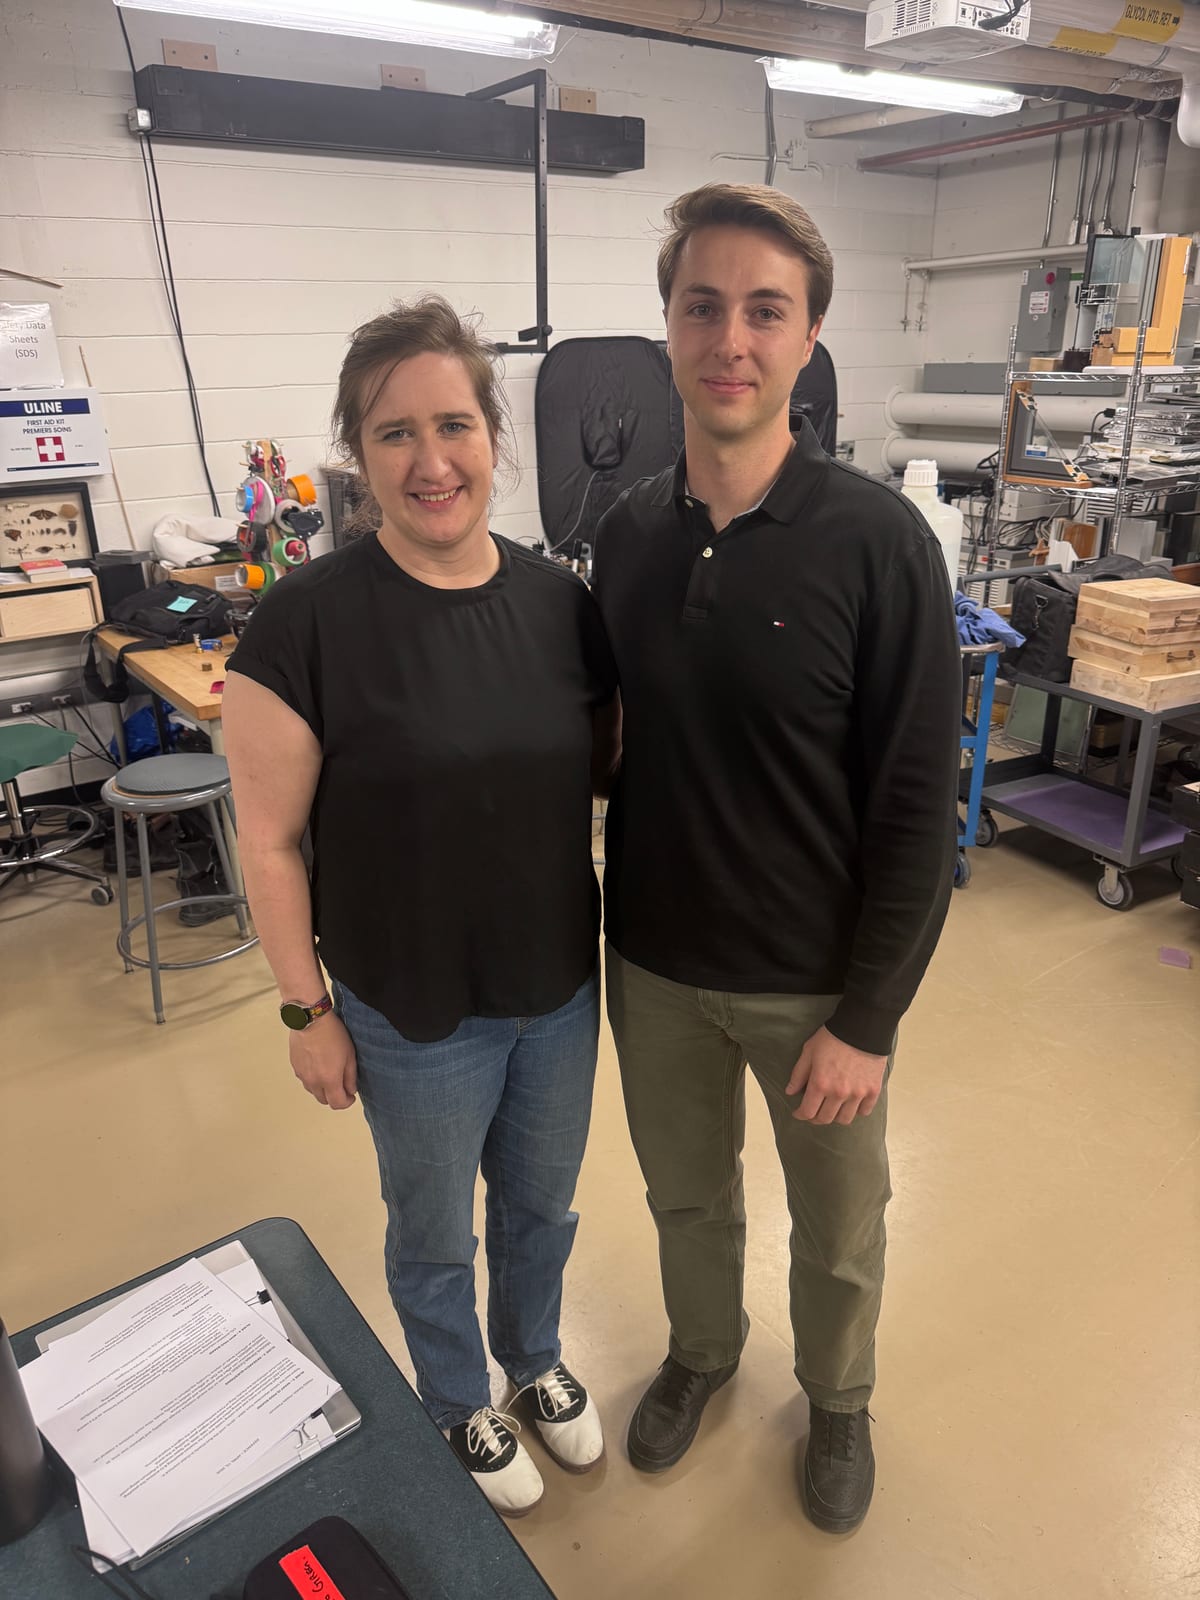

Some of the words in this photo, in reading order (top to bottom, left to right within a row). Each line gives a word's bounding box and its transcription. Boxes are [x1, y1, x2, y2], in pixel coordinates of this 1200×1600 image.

[26, 321, 46, 330] Data
[9, 335, 39, 344] Sheets
[15, 349, 38, 359] (SDS)
[23, 401, 63, 414] ULINE
[22, 427, 52, 435] PREMIERS
